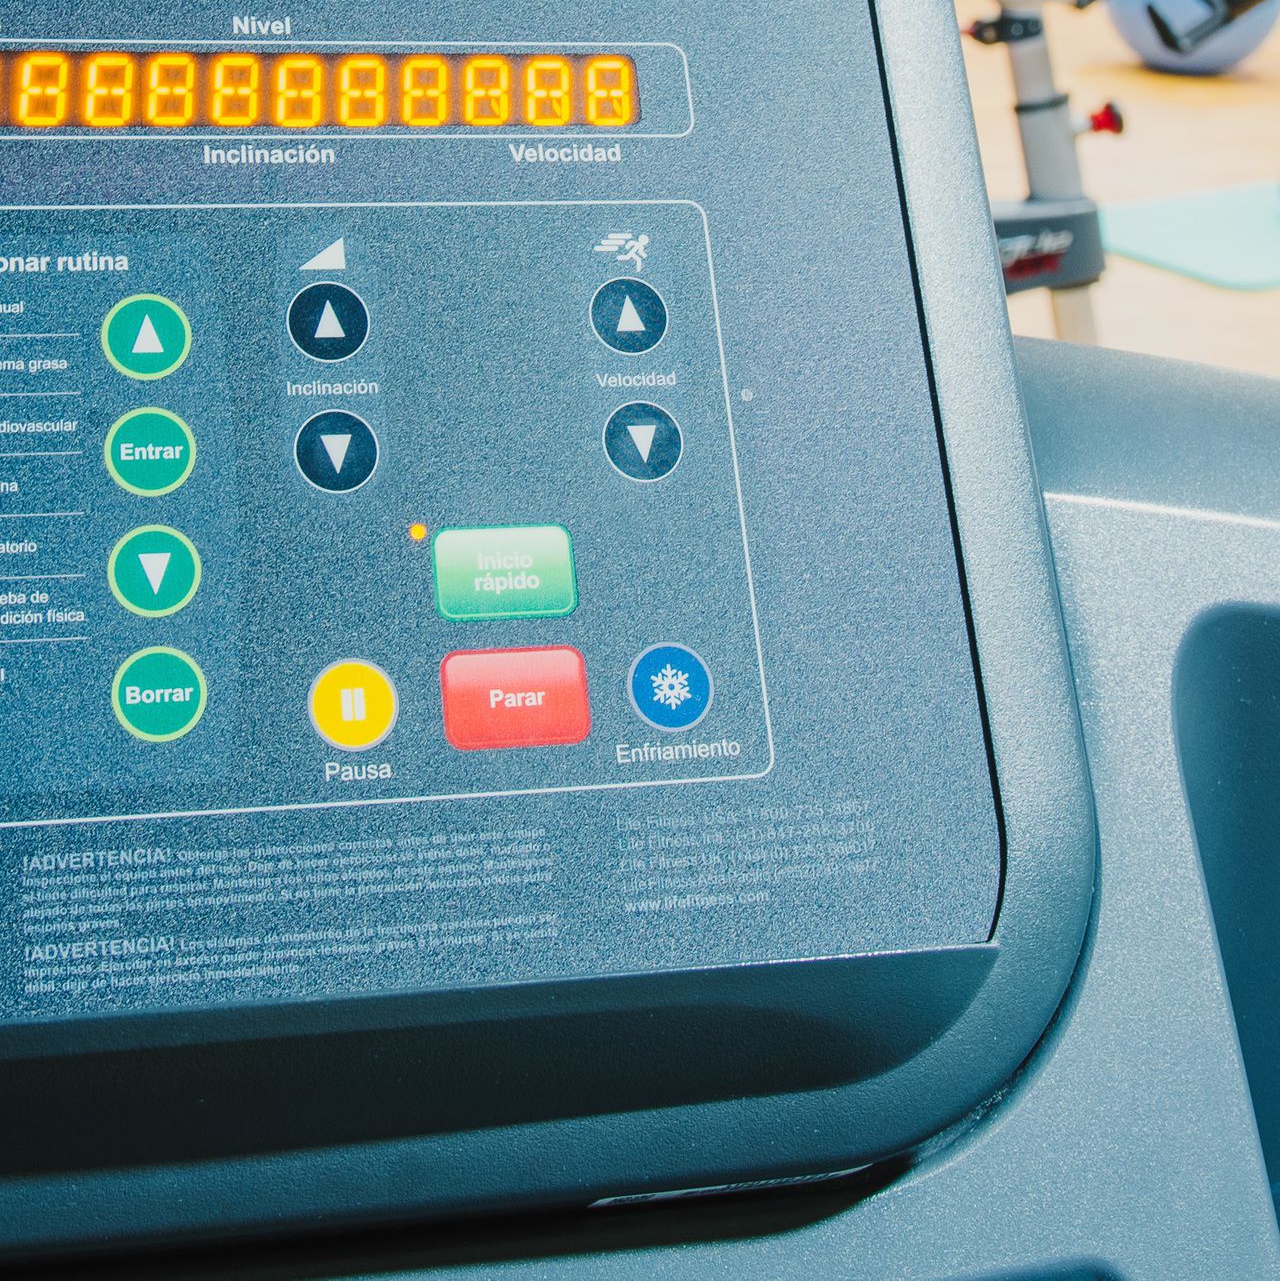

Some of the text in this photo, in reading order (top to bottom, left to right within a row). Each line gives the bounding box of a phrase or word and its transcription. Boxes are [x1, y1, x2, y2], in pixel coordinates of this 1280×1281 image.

[233, 17, 291, 35] Nivel
[203, 144, 335, 165] Inclinación
[509, 144, 622, 163] Velocidad
[56, 253, 128, 272] rutina
[28, 359, 67, 373] grasa
[285, 378, 379, 396] Inclinación
[596, 371, 677, 388] Velocidad
[120, 442, 183, 461] Entrar
[477, 551, 534, 571] Inicio
[474, 570, 540, 594] rápido
[29, 590, 49, 605] de
[46, 608, 84, 624] física
[125, 684, 193, 705] Borrar
[489, 688, 546, 708] Parar
[615, 738, 741, 764] Enfriamiento
[324, 761, 393, 782] Pausa
